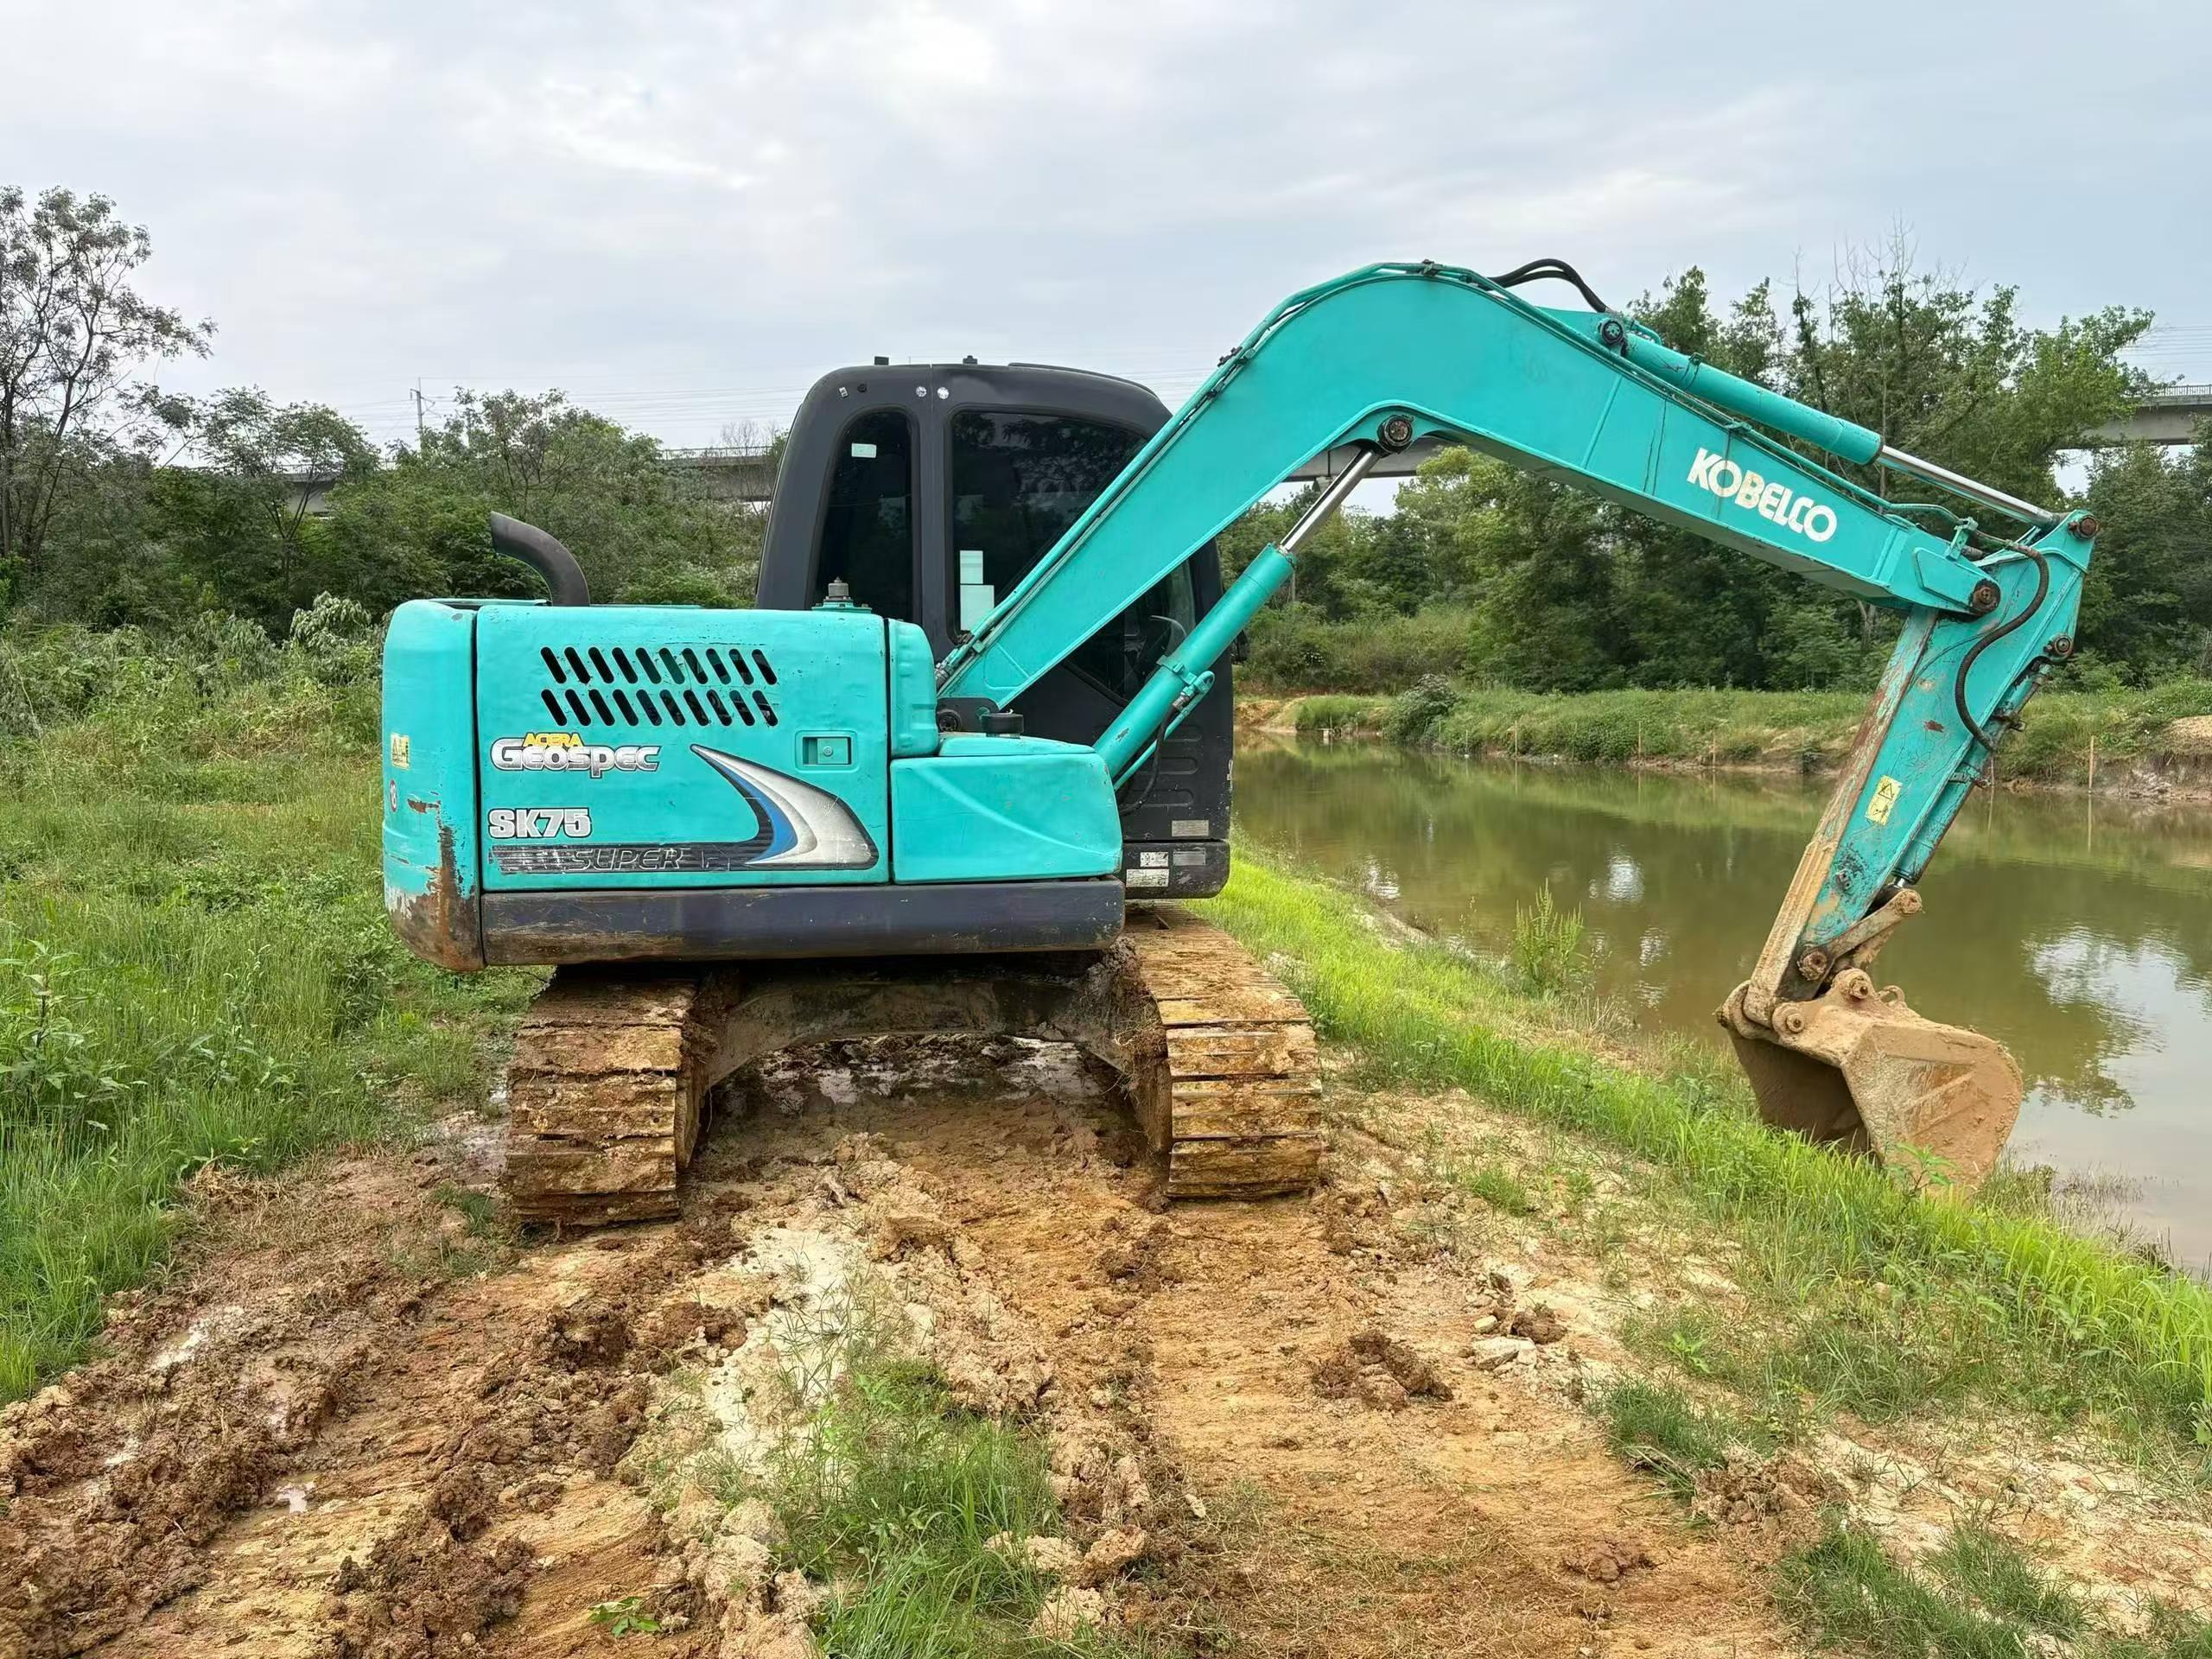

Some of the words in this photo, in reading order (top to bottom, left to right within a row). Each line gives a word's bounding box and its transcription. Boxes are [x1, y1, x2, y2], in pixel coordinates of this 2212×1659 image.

[1687, 447, 1838, 542] KOBELCO
[523, 732, 583, 747] ACERA
[489, 809, 592, 838] SK75
[567, 848, 686, 871] SUPER
